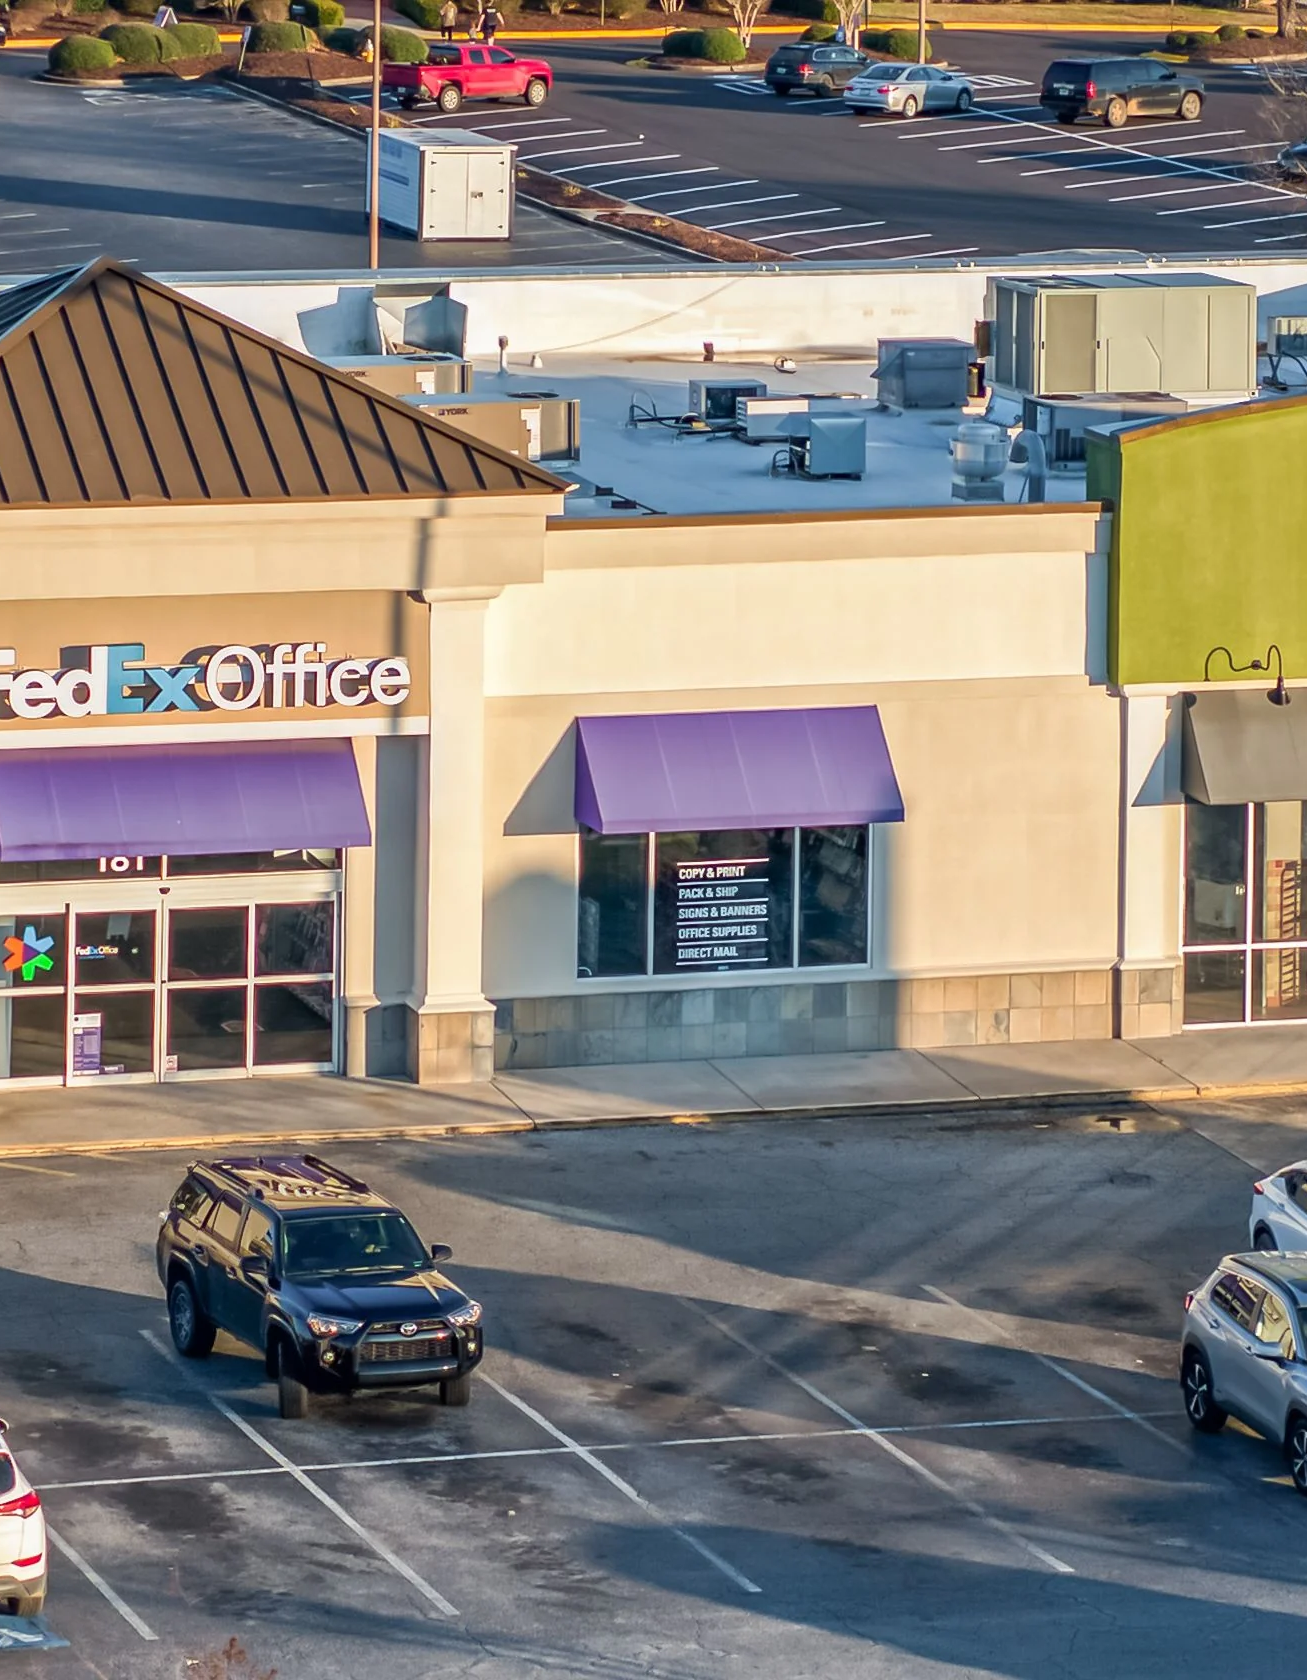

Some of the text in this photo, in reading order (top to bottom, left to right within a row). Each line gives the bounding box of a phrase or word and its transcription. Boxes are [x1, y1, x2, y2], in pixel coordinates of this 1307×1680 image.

[204, 642, 412, 712] Office
[679, 866, 746, 880] COPY & PRINT
[678, 886, 739, 899] PACK & SHIP
[678, 904, 767, 919] SIGNS & BANNERS
[678, 925, 758, 939] OFFICE SUPPLIES
[678, 946, 739, 959] DIRECT MAIL
